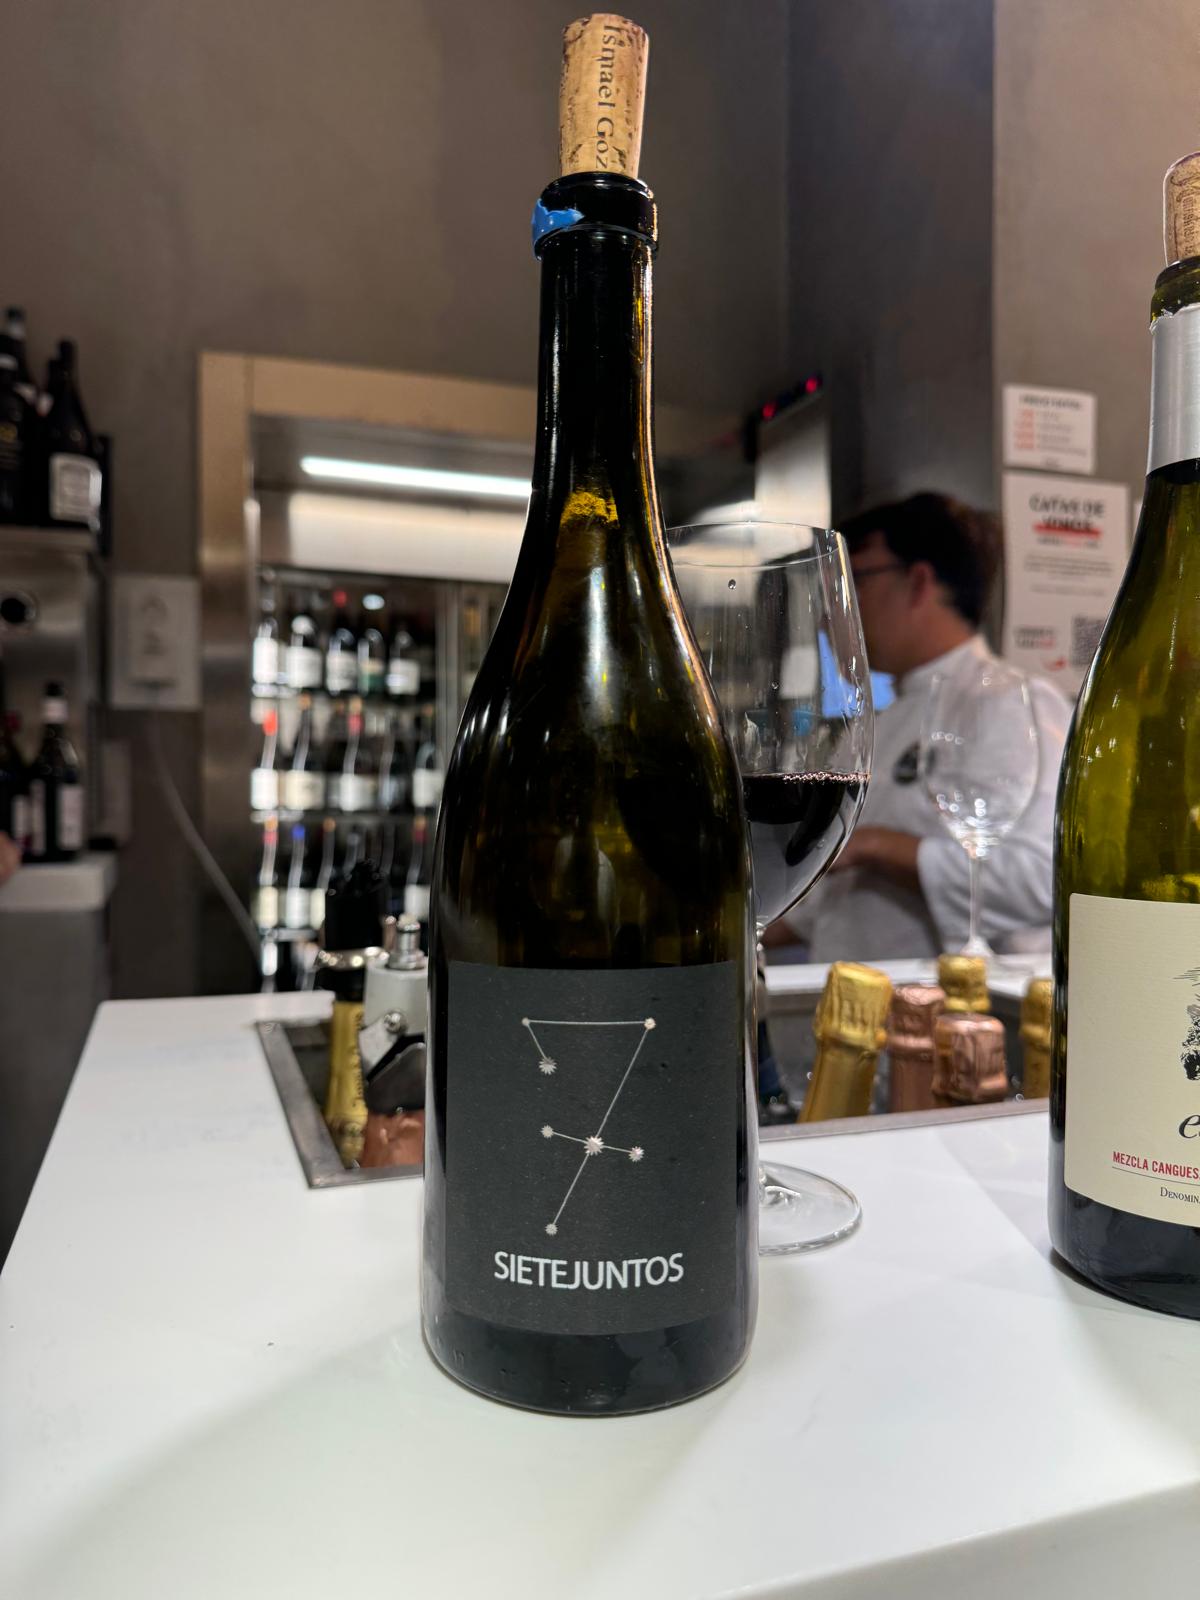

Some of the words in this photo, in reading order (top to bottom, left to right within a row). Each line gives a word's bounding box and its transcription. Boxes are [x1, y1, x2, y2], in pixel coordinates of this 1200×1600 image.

[598, 25, 620, 108] Ismael
[1112, 1151, 1149, 1171] MEZCLA
[1152, 1160, 1200, 1180] CANGUES
[1160, 1186, 1200, 1204] DENOMIN
[494, 1250, 684, 1290] SIETEJUNTOS
